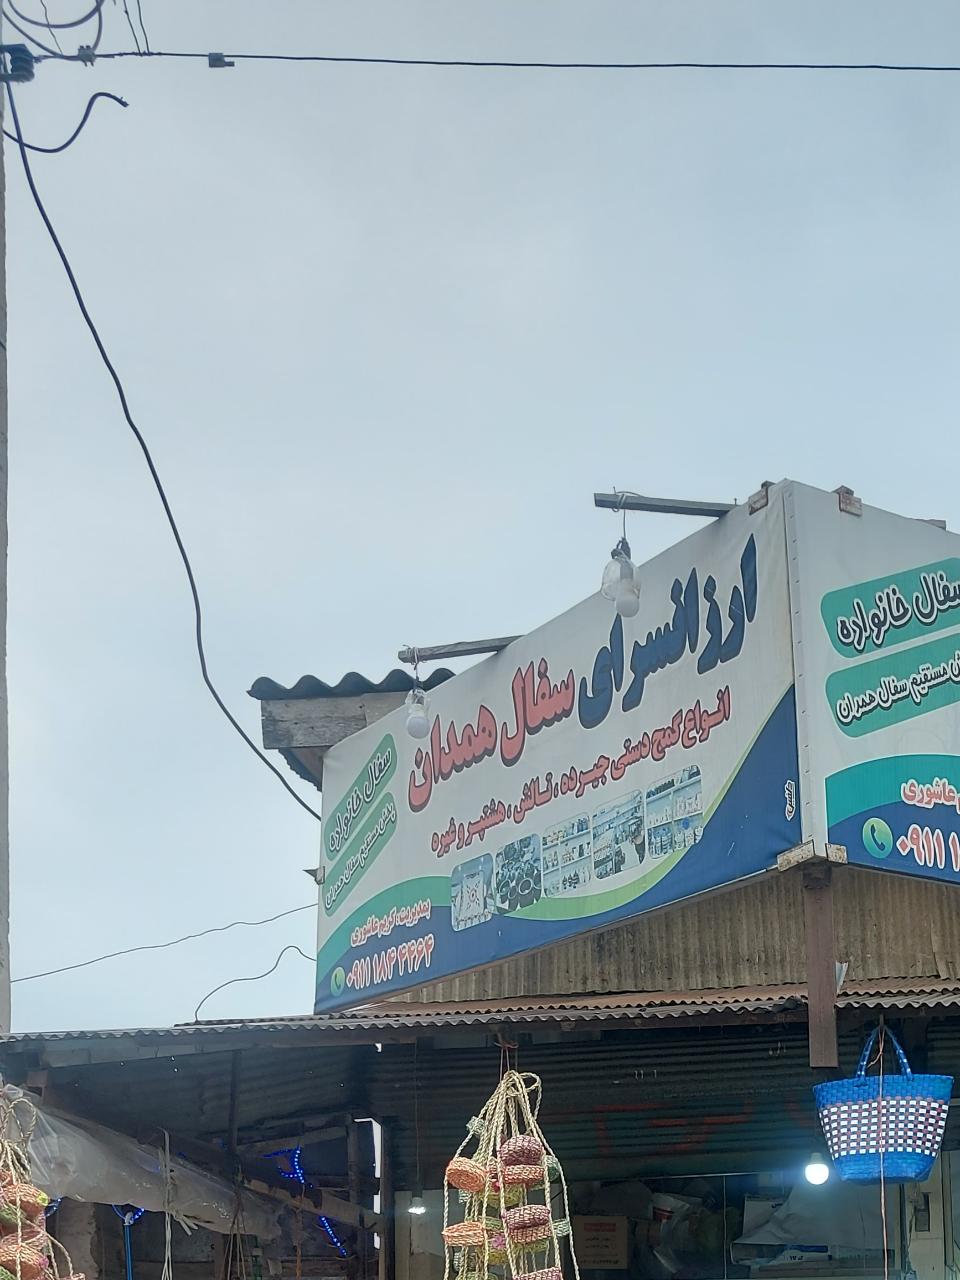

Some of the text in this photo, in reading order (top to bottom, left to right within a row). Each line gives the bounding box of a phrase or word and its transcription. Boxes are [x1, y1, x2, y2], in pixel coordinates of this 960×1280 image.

[837, 584, 912, 652] خانواده
[408, 532, 758, 813] ارزانسرای سفال همدان
[878, 676, 910, 710] سفال
[909, 663, 950, 705] مستقیم
[682, 685, 730, 749] انواع
[611, 732, 650, 780] دستی
[329, 748, 392, 852] سفال خانواده
[901, 777, 957, 808] عاشوری
[432, 817, 457, 858] غیره
[457, 822, 465, 850] و
[465, 798, 506, 847] هشتپر
[896, 824, 945, 869] ۰۹۱۱
[351, 914, 380, 947] عاشوری
[346, 957, 371, 990] ۰۹۱۱
